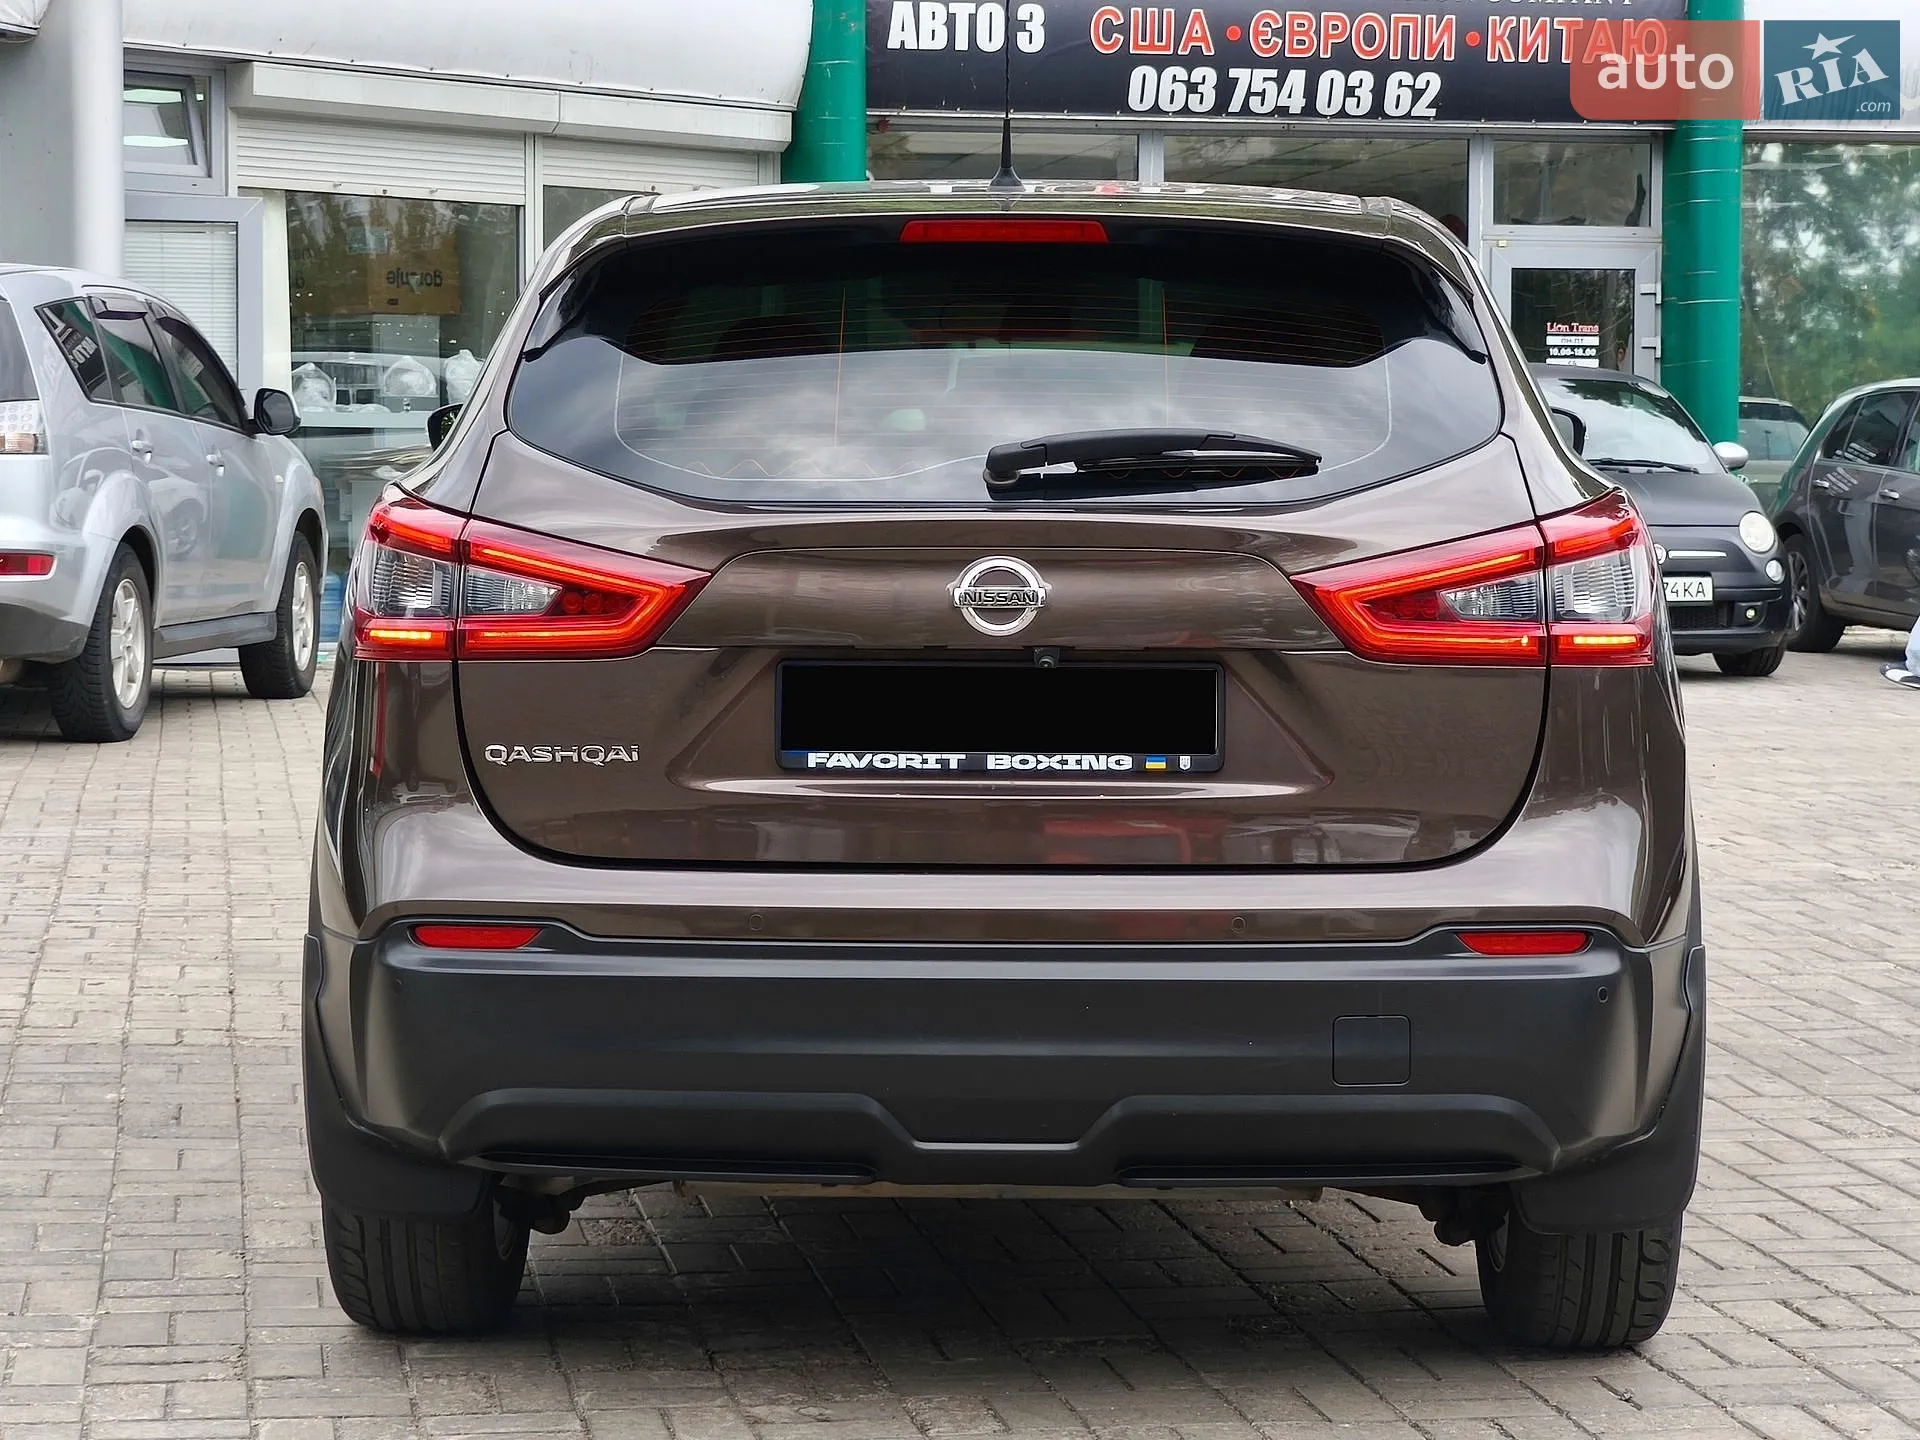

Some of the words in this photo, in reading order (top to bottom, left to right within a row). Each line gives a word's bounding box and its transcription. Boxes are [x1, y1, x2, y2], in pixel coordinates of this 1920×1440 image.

[887, 1, 1005, 52] АВТО
[1090, 6, 1215, 54] США
[1250, 11, 1456, 61] ЄВРОПИ
[1486, 15, 1668, 65] КИТАЮ
[1128, 65, 1217, 113] 063
[1228, 68, 1306, 114] 754
[1315, 70, 1374, 116] 03
[1383, 71, 1441, 117] 62
[963, 591, 1037, 604] NISSAN
[807, 752, 967, 769] FAVORIT
[986, 754, 1133, 771] BOXING
